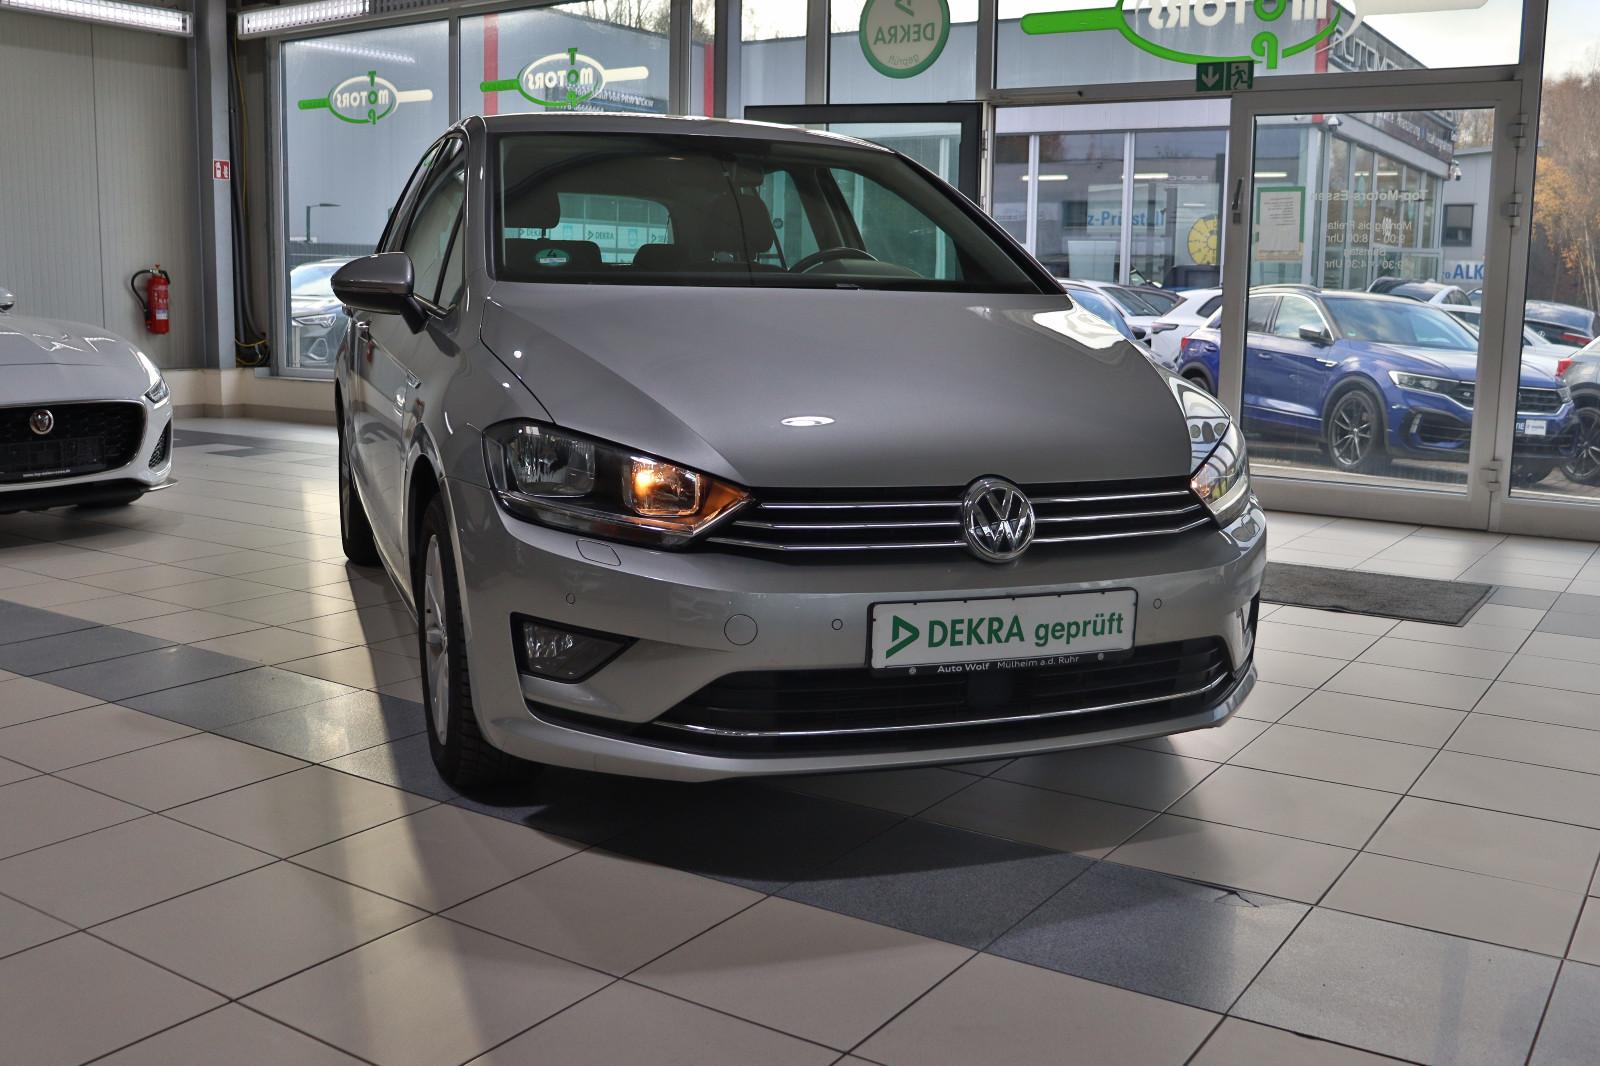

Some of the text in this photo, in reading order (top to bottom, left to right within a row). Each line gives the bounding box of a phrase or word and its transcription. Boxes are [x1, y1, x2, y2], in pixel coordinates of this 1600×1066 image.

[927, 611, 1124, 648] DEKRA geprüft
[937, 664, 963, 673] Auto
[964, 662, 991, 671] Wolf
[997, 660, 1038, 670] Mülheim
[1058, 655, 1080, 664] Ruhr
